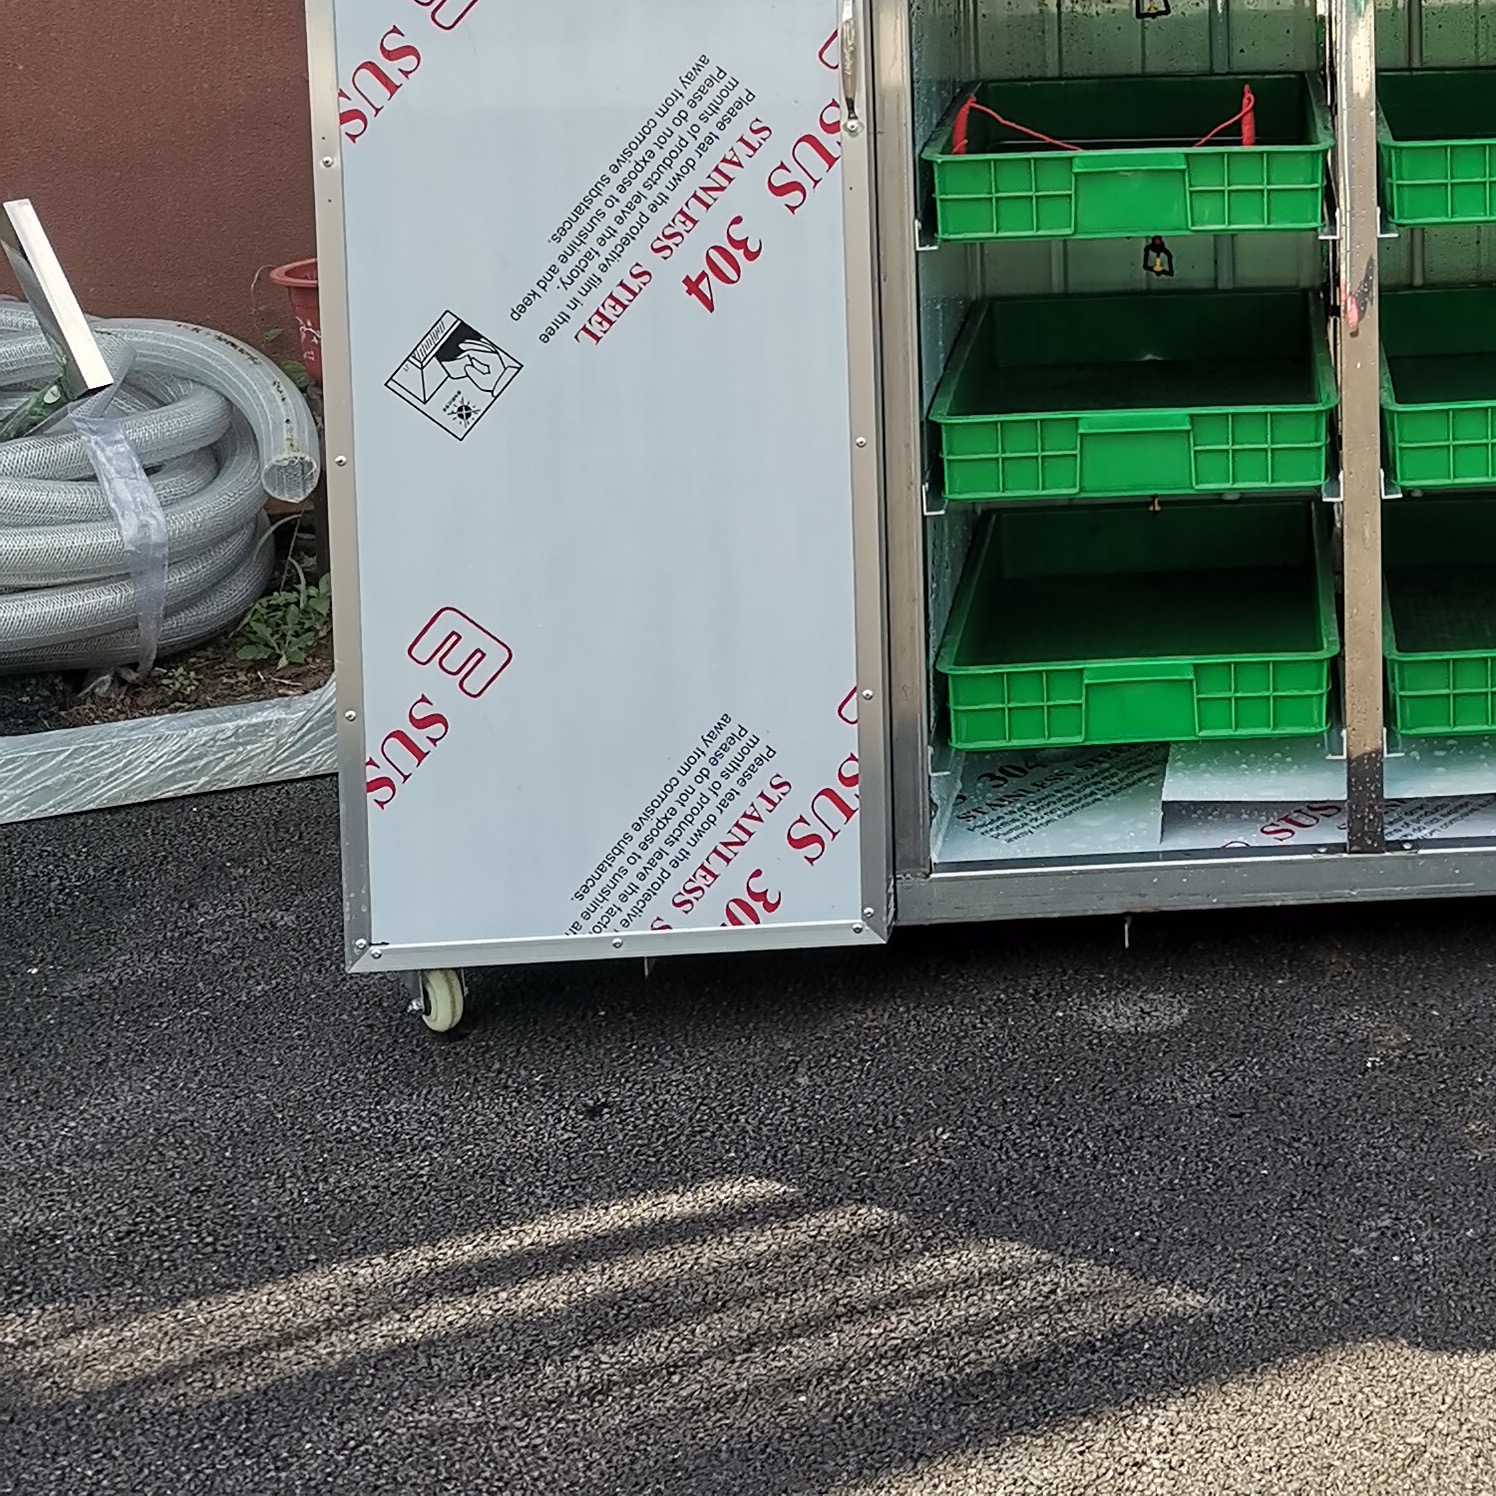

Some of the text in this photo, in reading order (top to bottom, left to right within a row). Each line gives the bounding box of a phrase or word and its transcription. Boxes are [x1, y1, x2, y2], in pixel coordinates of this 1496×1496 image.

[548, 54, 710, 244] away from corrosive substances.
[510, 65, 728, 322] Please do not expose to sunshine and keep
[556, 76, 740, 291] months of products leave the factory.
[538, 88, 756, 344] Please tear down the protective film in three
[573, 117, 773, 346] STAINLESS STEEL
[681, 215, 763, 314] 304
[708, 723, 749, 767] Please
[719, 734, 761, 781] months
[736, 744, 777, 788] Please
[674, 784, 696, 808] not
[693, 767, 711, 785] do
[707, 780, 722, 798] of
[570, 713, 732, 902] away from corrosive substances.
[663, 791, 711, 848] products
[715, 787, 741, 815] tear
[1260, 803, 1342, 842] SUS
[637, 806, 678, 852] expose
[671, 772, 792, 915] STAINLESS
[685, 813, 718, 848] down
[626, 851, 643, 866] to
[635, 847, 670, 882] leave
[668, 847, 691, 869] the
[580, 865, 629, 921] sunshine
[618, 881, 640, 903] the
[619, 866, 672, 929] protective
[720, 868, 782, 928] 30
[588, 903, 623, 935] facto
